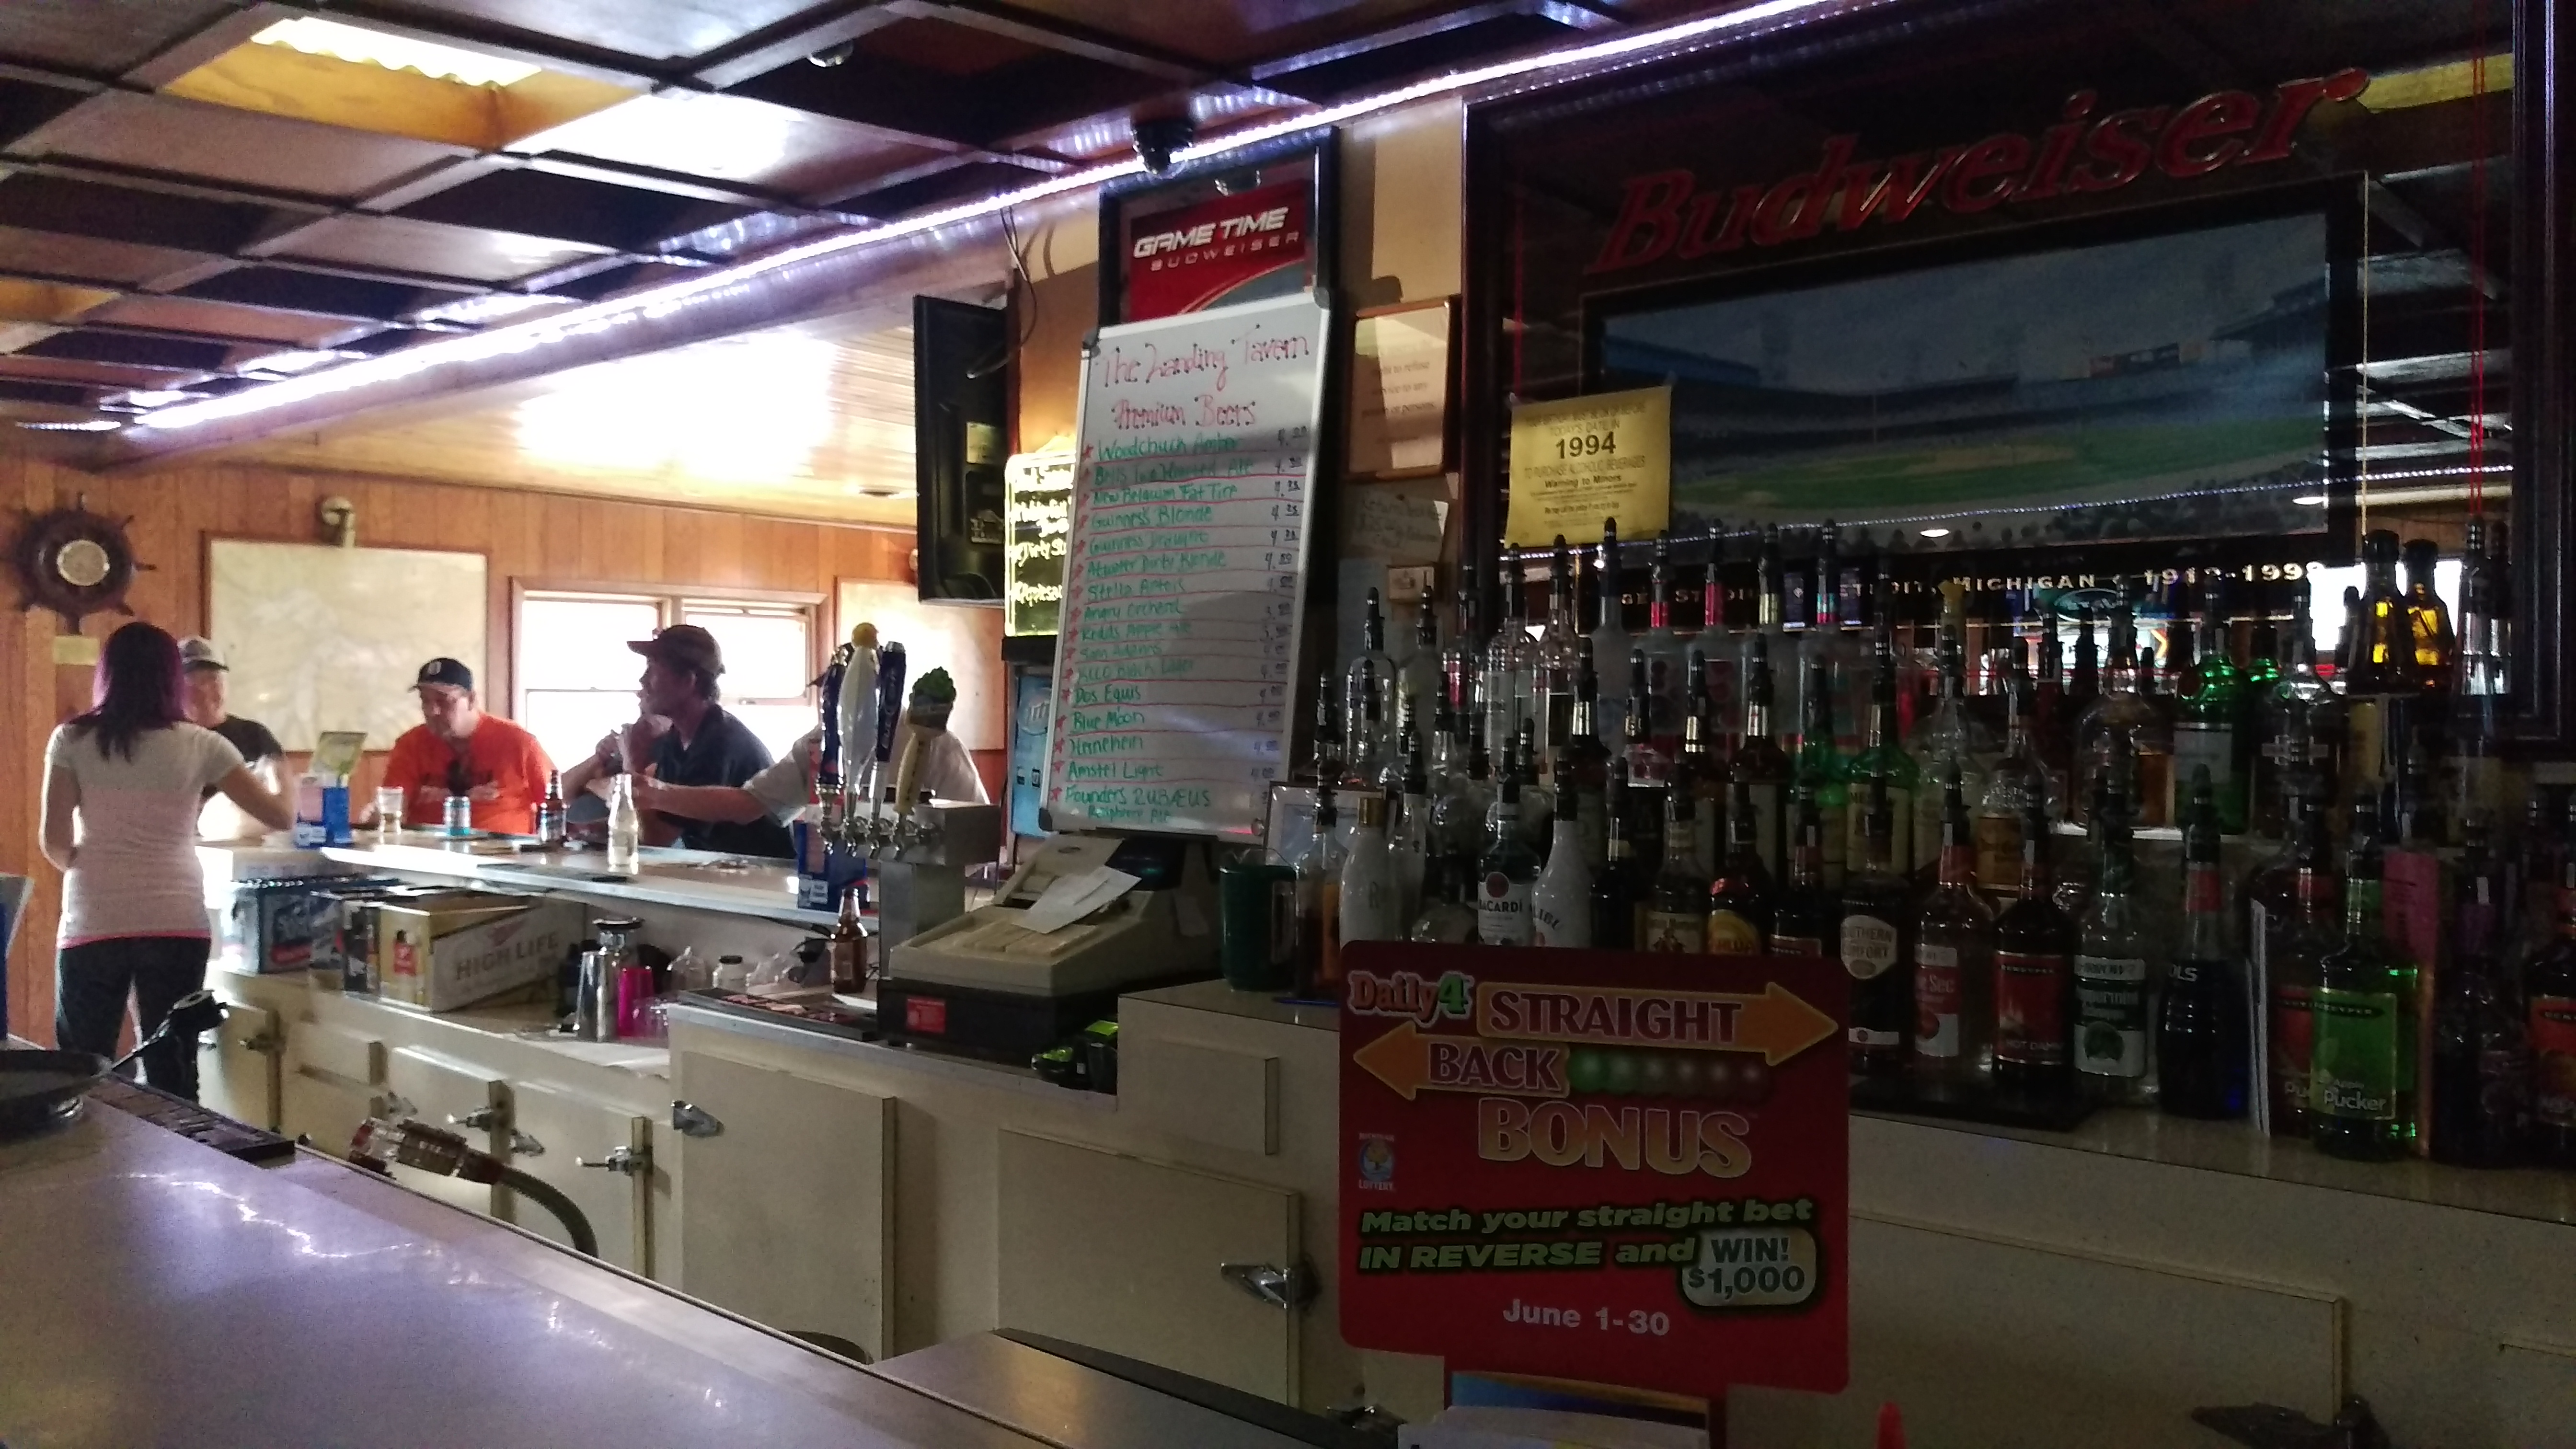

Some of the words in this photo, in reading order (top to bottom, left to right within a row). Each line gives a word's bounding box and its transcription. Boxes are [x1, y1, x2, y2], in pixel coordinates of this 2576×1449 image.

[1583, 67, 2370, 274] Budweiser
[1133, 223, 1216, 258] GAME
[1220, 206, 1289, 240] TIME
[1150, 231, 1300, 271] BUDWEISER
[1104, 348, 1139, 387] The
[1145, 343, 1228, 390] Landing
[1232, 324, 1309, 363] Tavern
[1112, 399, 1185, 429] Premium
[1195, 394, 1256, 427] Beers
[1556, 431, 1616, 459] 1994
[1954, 574, 2096, 592] MICHIGAN
[1076, 688, 1098, 703] Dos
[1104, 684, 1141, 702] Equis
[1073, 711, 1102, 731] Blue
[1107, 706, 1145, 729] Moon
[516, 932, 558, 958] LIFE
[1490, 991, 1741, 1042] STRAIGHT
[1428, 1042, 1561, 1092] BACK
[2325, 1090, 2386, 1112] Pucker
[1478, 1097, 1751, 1178] BONUS
[1361, 1209, 1472, 1233] Match
[1481, 1211, 1569, 1235] your
[1577, 1200, 1734, 1230] straight
[1744, 1199, 1812, 1222] bet
[1359, 1246, 1401, 1270] IN
[1410, 1242, 1601, 1269] REVERSE
[1616, 1238, 1695, 1263] and
[1710, 1237, 1791, 1264] WIN!
[1688, 1266, 1805, 1300] $1,000
[1503, 1299, 1581, 1328] June
[1596, 1308, 1669, 1336] 1-30
